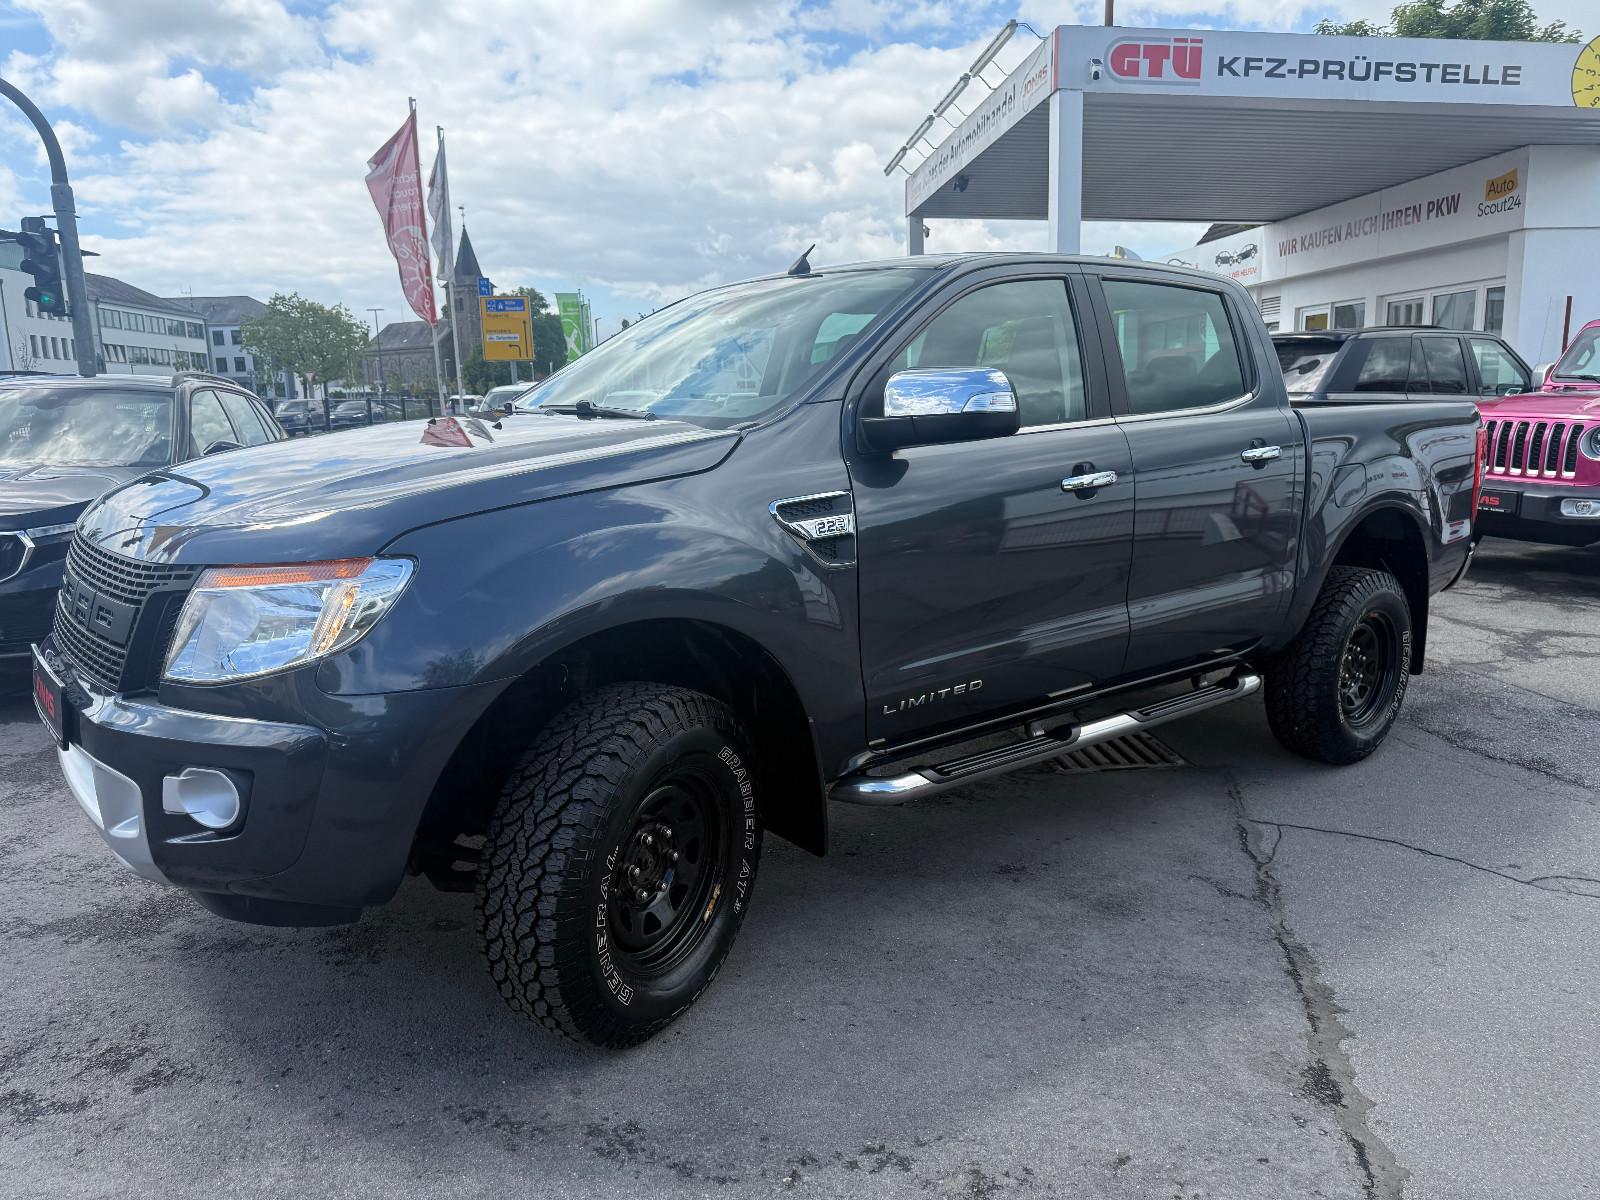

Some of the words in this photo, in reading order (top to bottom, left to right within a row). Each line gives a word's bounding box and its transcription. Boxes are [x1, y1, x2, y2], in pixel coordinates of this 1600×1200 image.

[1110, 37, 1203, 79] GTÜ
[1217, 55, 1522, 86] KFZ-PRÜFSTELLE
[950, 84, 1016, 160] Automobilhandel
[1477, 194, 1522, 217] Scout24
[1487, 177, 1514, 196] Auto
[1278, 238, 1298, 257] WIR
[1300, 226, 1342, 252] KAUFEN
[1344, 215, 1378, 243] AUCH
[1381, 203, 1422, 231] IHREN
[1426, 192, 1461, 221] PKW
[883, 679, 983, 715] LIMITED
[717, 746, 755, 850] GRABBER
[596, 845, 634, 1006] GENERAL
